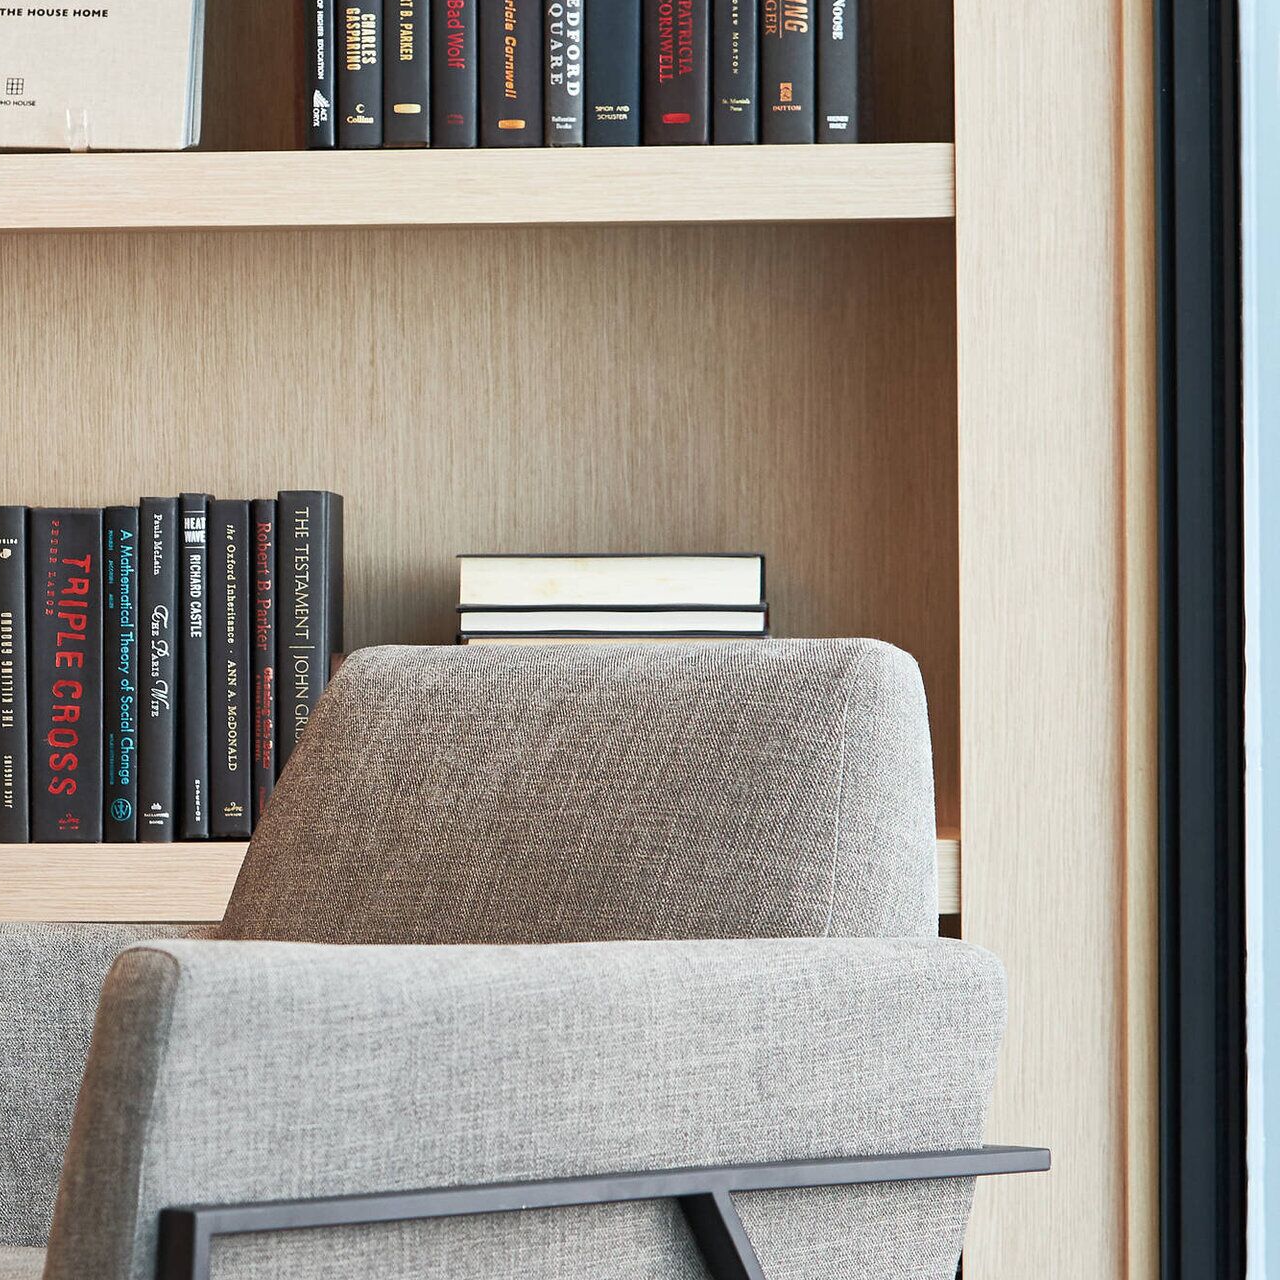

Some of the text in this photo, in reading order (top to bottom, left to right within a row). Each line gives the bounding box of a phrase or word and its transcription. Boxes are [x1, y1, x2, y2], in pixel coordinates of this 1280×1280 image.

[0, 8, 23, 17] THE
[27, 9, 68, 17] HOUSE
[73, 9, 108, 17] HOME
[447, 0, 464, 28] Bad
[678, 0, 692, 75] PATRICIA
[447, 33, 464, 69] Wolf
[505, 36, 516, 98] Cornwell
[153, 514, 163, 575] Paula McLain
[294, 507, 309, 639] THE TESTAMENT
[55, 555, 91, 668] TRIPLE
[190, 555, 201, 638] RICHARD CASTLE
[226, 525, 237, 644] the Oxford Inheritance
[119, 530, 133, 785] A Mathematical Theory of Social Change
[228, 660, 236, 685] ANN
[293, 655, 308, 699] JOHN
[228, 690, 236, 702] A.
[43, 680, 83, 795] CROSS
